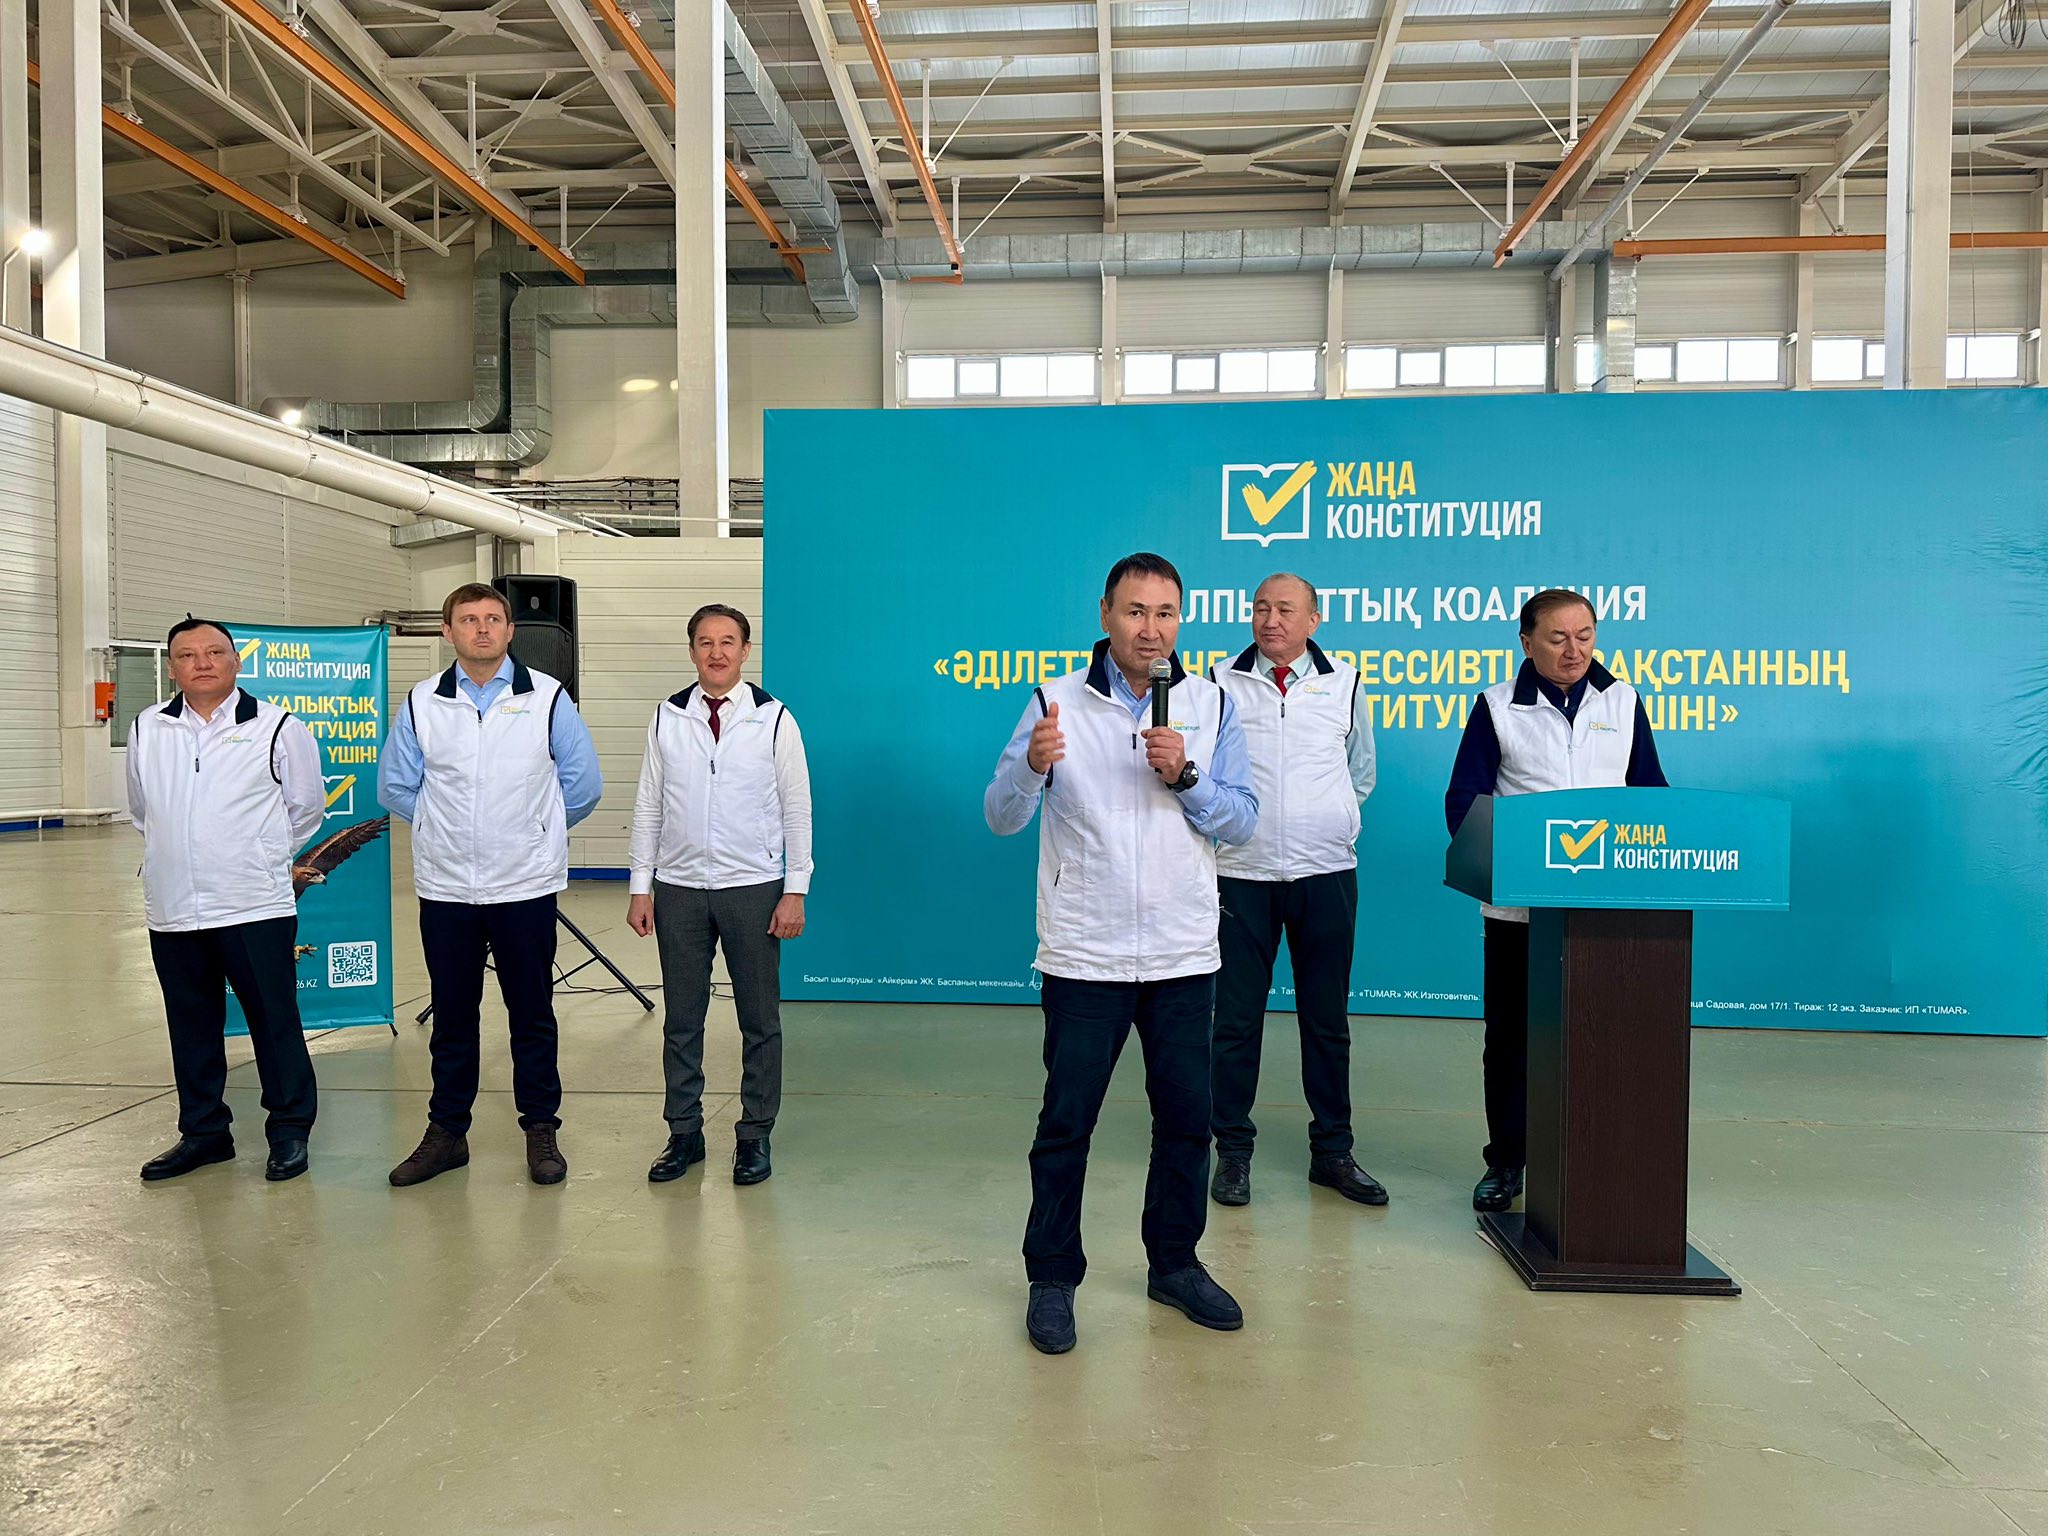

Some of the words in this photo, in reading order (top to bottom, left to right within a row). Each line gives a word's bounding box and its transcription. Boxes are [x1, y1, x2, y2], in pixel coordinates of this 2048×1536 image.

[1327, 461, 1416, 500] ЖАҢА
[1327, 501, 1541, 540] КОНСТИТУЦИЯ
[266, 642, 311, 660] ЖАҢА
[266, 661, 371, 680] КОНСТИТУЦИЯ
[327, 746, 377, 763] ҮШІН!
[1614, 824, 1667, 847] ЖАҢА
[1614, 848, 1739, 872] КОНСТИТУЦИЯ
[803, 974, 829, 983] Басып
[1705, 999, 1747, 1010] Садовая,
[1748, 1002, 1768, 1010] дом
[1769, 1001, 1791, 1011] 17/1.
[1793, 1002, 1825, 1012] Тираж:
[1827, 1003, 1838, 1012] 12
[1840, 1004, 1857, 1013] экз.
[1904, 1005, 1920, 1014] ИП
